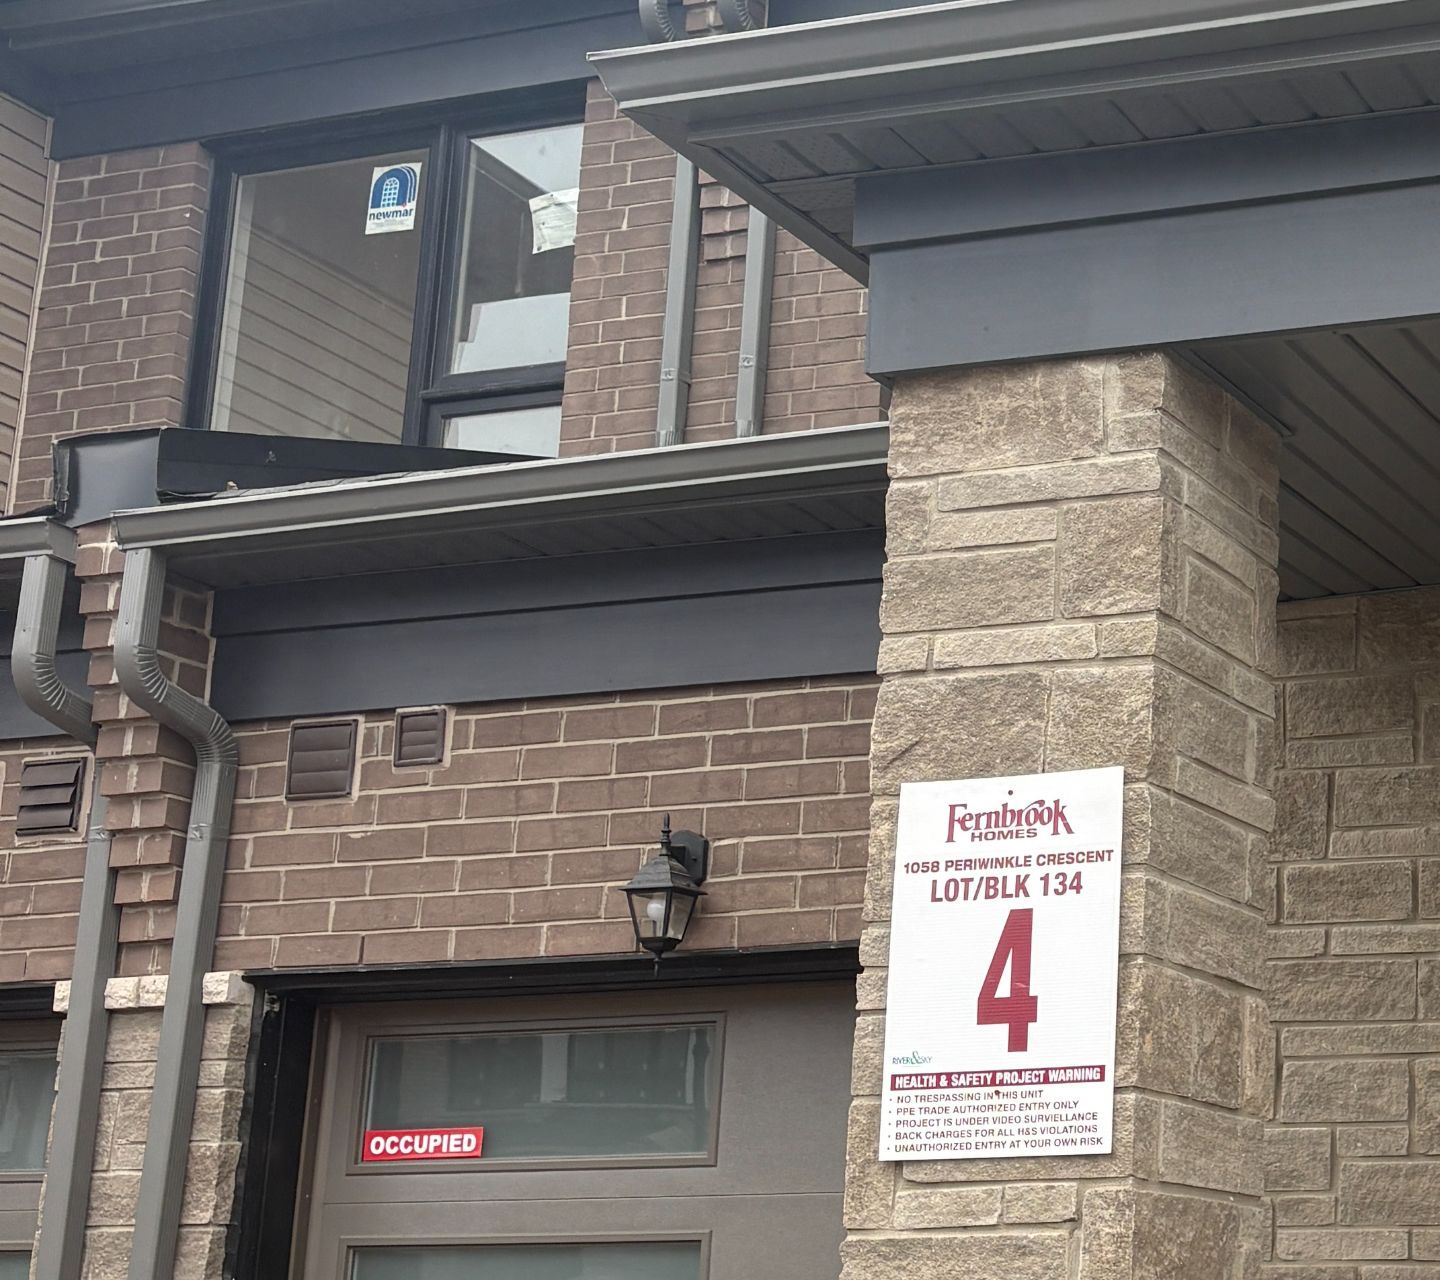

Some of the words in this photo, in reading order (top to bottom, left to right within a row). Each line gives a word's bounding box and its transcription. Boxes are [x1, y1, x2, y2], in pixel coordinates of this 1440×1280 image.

[369, 208, 413, 220] newmar
[945, 799, 1075, 843] Fernbrook
[971, 828, 1038, 842] HOMES
[904, 861, 940, 874] 1058
[944, 855, 1032, 871] PERIWINKLE
[1036, 849, 1114, 866] CRESCENT
[930, 874, 1031, 903] LOT/BLK
[1040, 871, 1083, 897] 134
[977, 908, 1038, 1052] 4
[895, 1075, 936, 1089] HEALTH
[939, 1075, 948, 1087] &
[951, 1072, 993, 1087] SAFETY
[995, 1070, 1045, 1085] PROJECT
[1048, 1067, 1101, 1082] WARNING
[897, 1095, 911, 1103] NO
[914, 1093, 981, 1103] TRESPASSING
[984, 1092, 993, 1100] IN
[997, 1090, 1018, 1099] THIS
[1020, 1090, 1044, 1099] UNIT
[896, 1107, 916, 1116] PPE
[918, 1106, 950, 1115] TRADE
[953, 1104, 1016, 1114] AUTHORIZED
[1019, 1102, 1050, 1111] ENTRY
[1053, 1100, 1079, 1109] ONLY
[896, 1119, 941, 1128] PROJECT
[943, 1118, 952, 1126] IS
[955, 1117, 989, 1126] UNDER
[992, 1115, 1021, 1124] VIDEO
[1024, 1112, 1098, 1123] SURVIELLANCE
[895, 1132, 922, 1140] BACK
[925, 1129, 972, 1139] CHARGES
[975, 1129, 994, 1137] FOR
[997, 1128, 1015, 1136] ALL
[1018, 1127, 1037, 1136] H&S
[1040, 1125, 1097, 1135] VIOLATIONS
[370, 1133, 476, 1154] OCCUPIED
[895, 1142, 972, 1152] UNAUTHORIZED
[975, 1140, 1006, 1150] ENTRY
[1009, 1140, 1021, 1148] AT
[1024, 1139, 1051, 1148] YOUR
[1054, 1138, 1077, 1147] OWN
[1080, 1136, 1103, 1146] RISK
